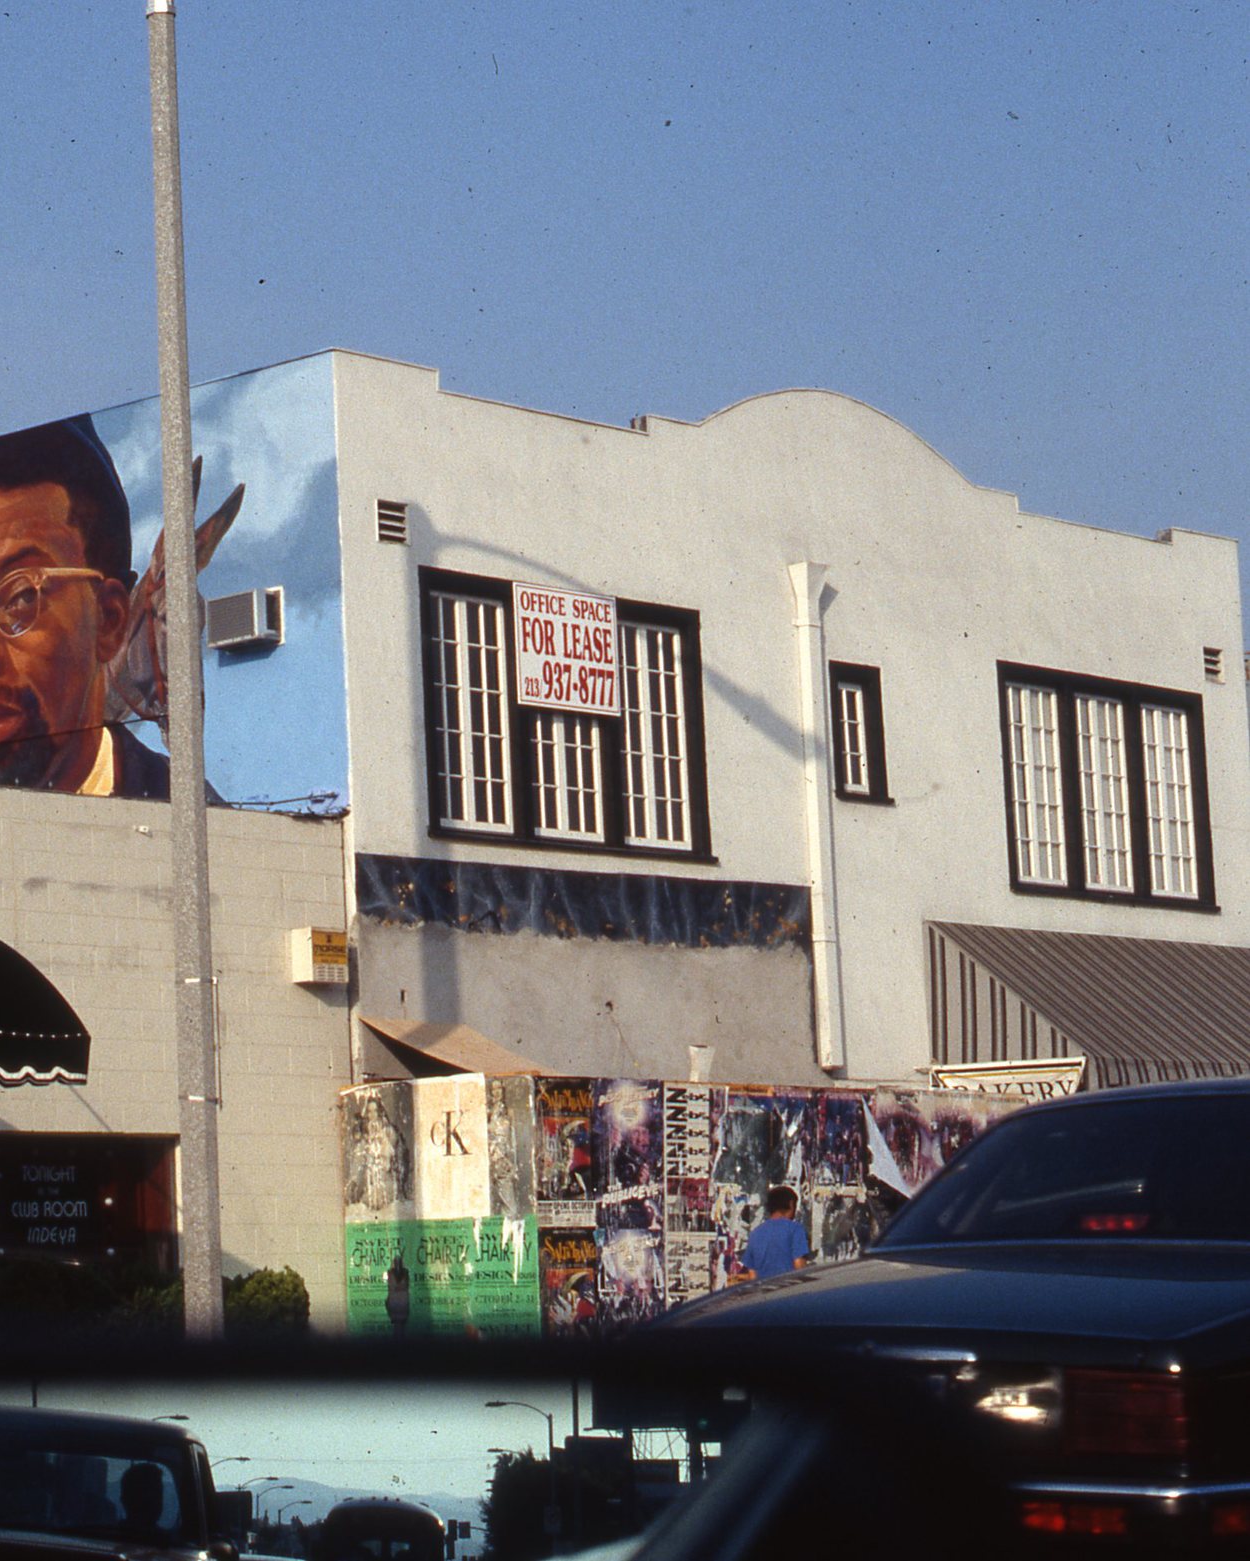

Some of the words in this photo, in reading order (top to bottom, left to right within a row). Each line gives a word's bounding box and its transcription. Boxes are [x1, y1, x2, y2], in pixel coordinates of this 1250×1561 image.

[520, 590, 566, 616] OFFICE
[572, 598, 612, 623] SPACE
[521, 616, 556, 656] FOR
[562, 622, 613, 664] LEASE
[953, 1080, 1074, 1101] KERY
[21, 1165, 77, 1182] TONIGHT
[11, 1200, 39, 1218] CLUB
[43, 1200, 88, 1217] ROOM
[475, 1241, 533, 1263] HAIR-Y
[476, 1269, 513, 1280] ESIGN
